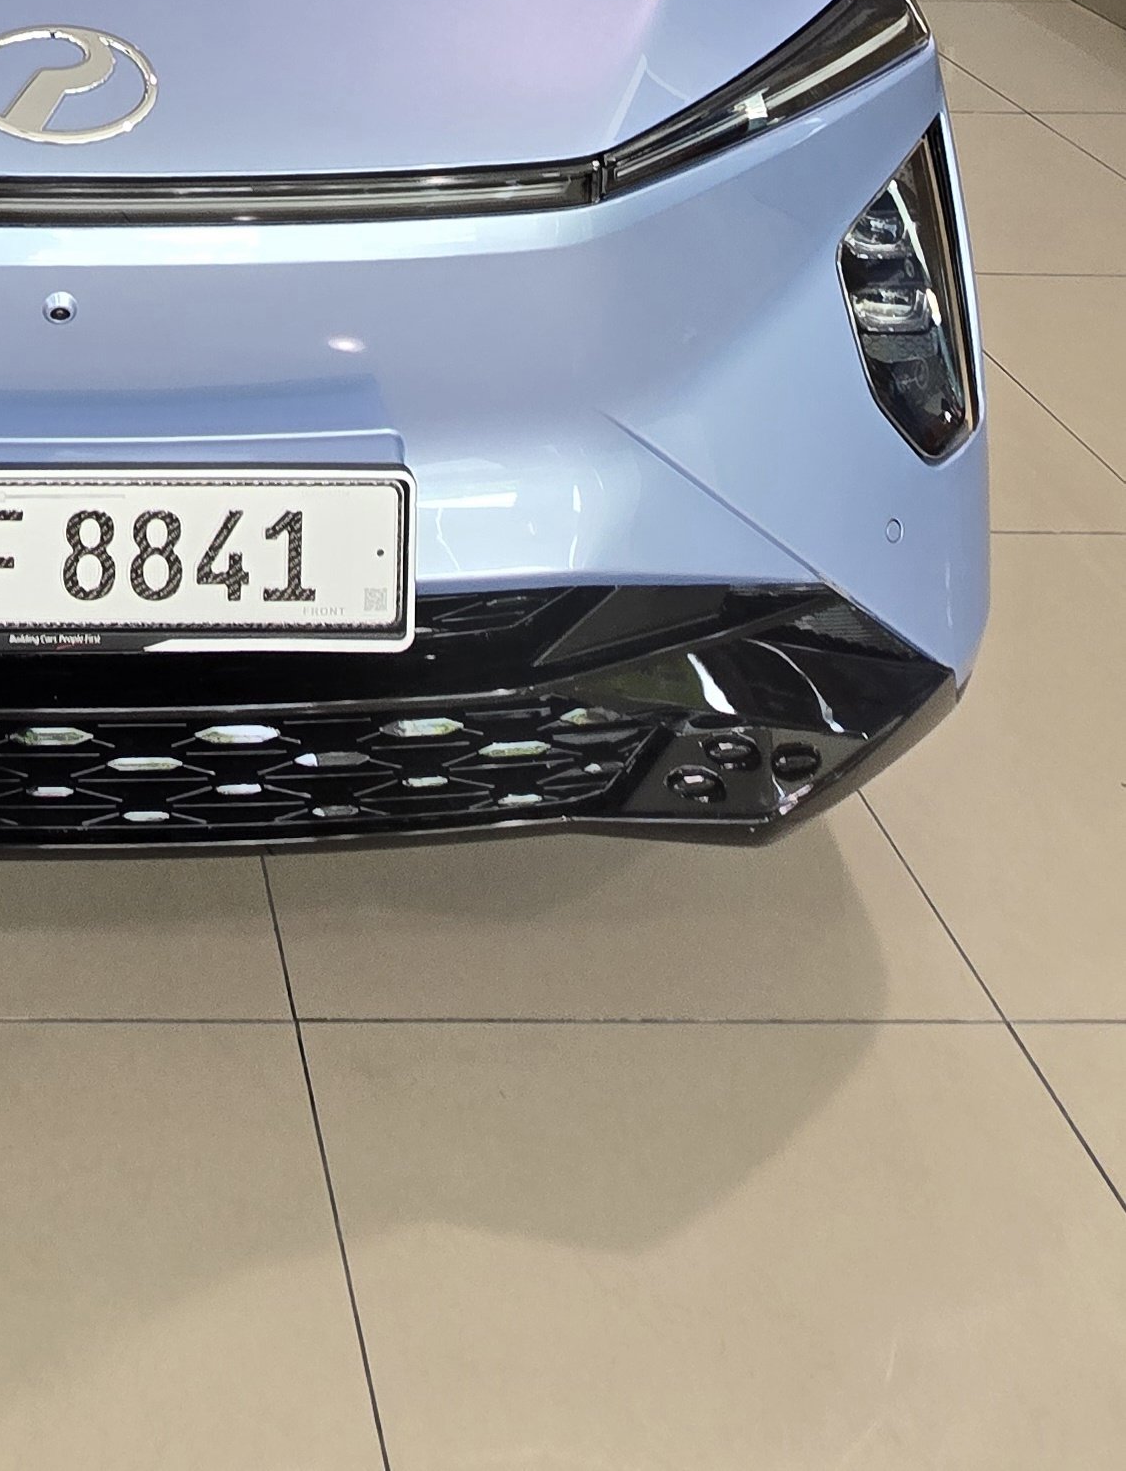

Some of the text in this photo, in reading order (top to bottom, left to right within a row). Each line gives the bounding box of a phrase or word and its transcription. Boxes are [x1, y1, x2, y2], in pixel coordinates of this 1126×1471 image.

[63, 510, 316, 602] 8841
[302, 607, 345, 616] FRONT
[59, 634, 83, 645] People
[84, 634, 101, 644] First
